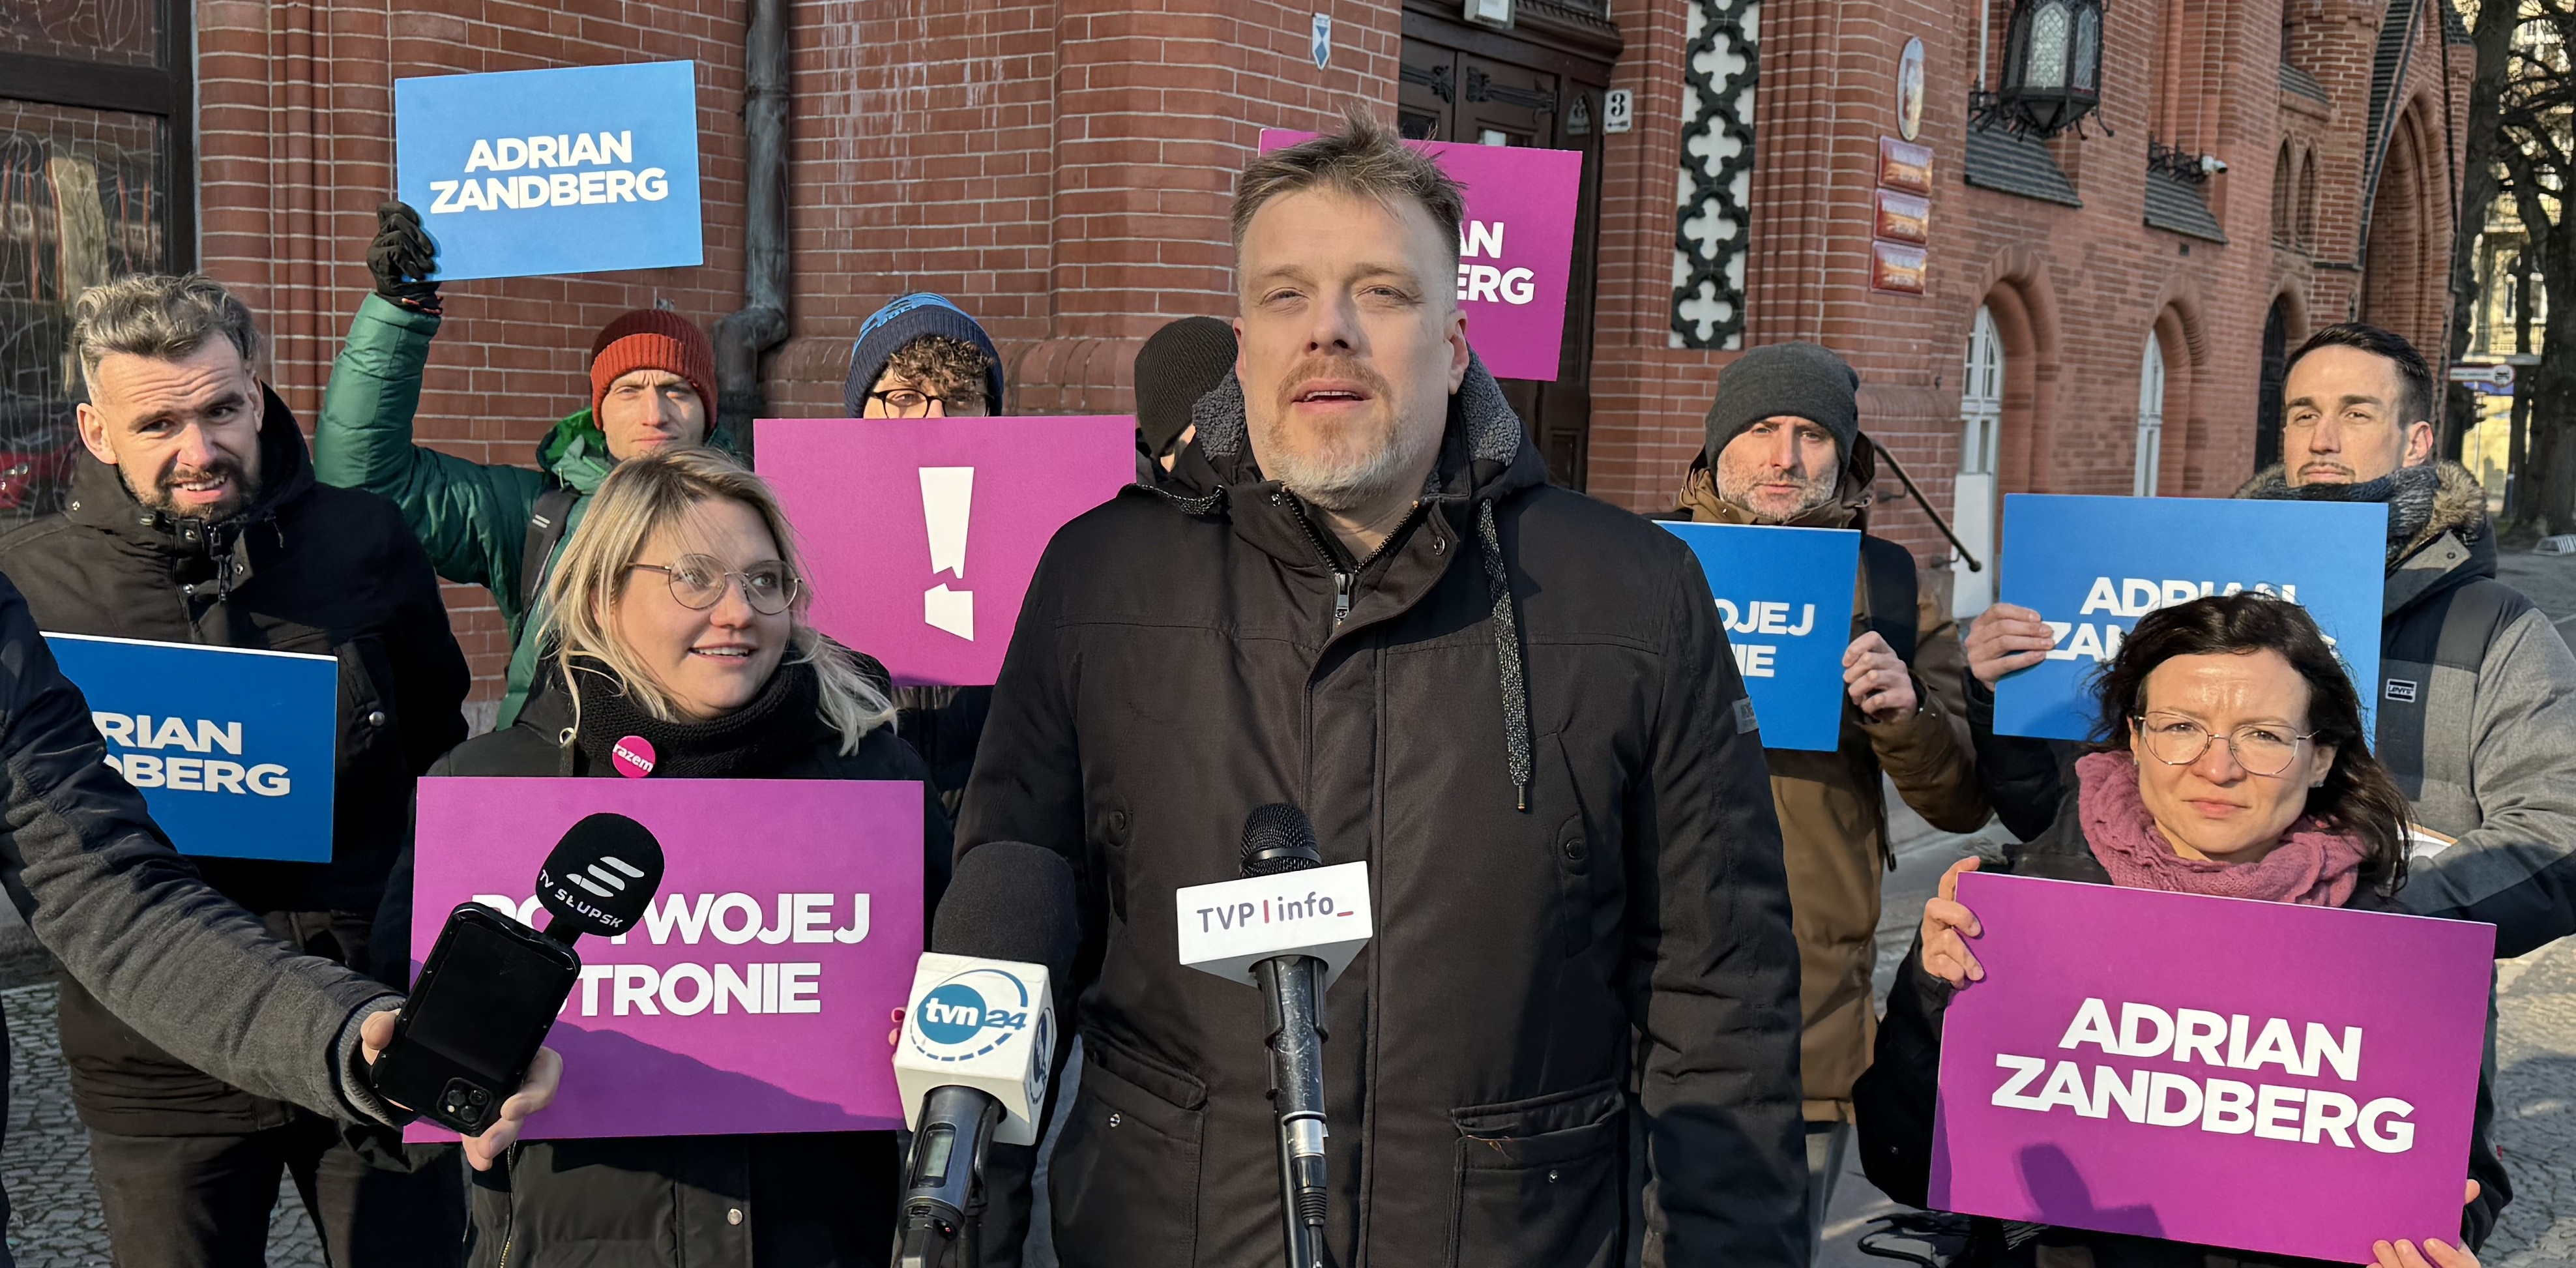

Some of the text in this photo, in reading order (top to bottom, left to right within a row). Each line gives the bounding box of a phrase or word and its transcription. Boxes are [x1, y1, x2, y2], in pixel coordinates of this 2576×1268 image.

[1611, 93, 1626, 117] 3
[464, 130, 632, 173] ADRIAN
[430, 167, 669, 214] ZANDBERG
[1714, 598, 1815, 636] OJEJ
[91, 711, 242, 755] RIAN
[612, 743, 654, 773] razem
[611, 892, 870, 945] WOJEJ
[1197, 902, 1255, 933] TVP
[557, 962, 821, 1016] TRONIE
[2058, 997, 2363, 1082] ADRIAN
[1991, 1054, 2415, 1153] ZANDBERG
